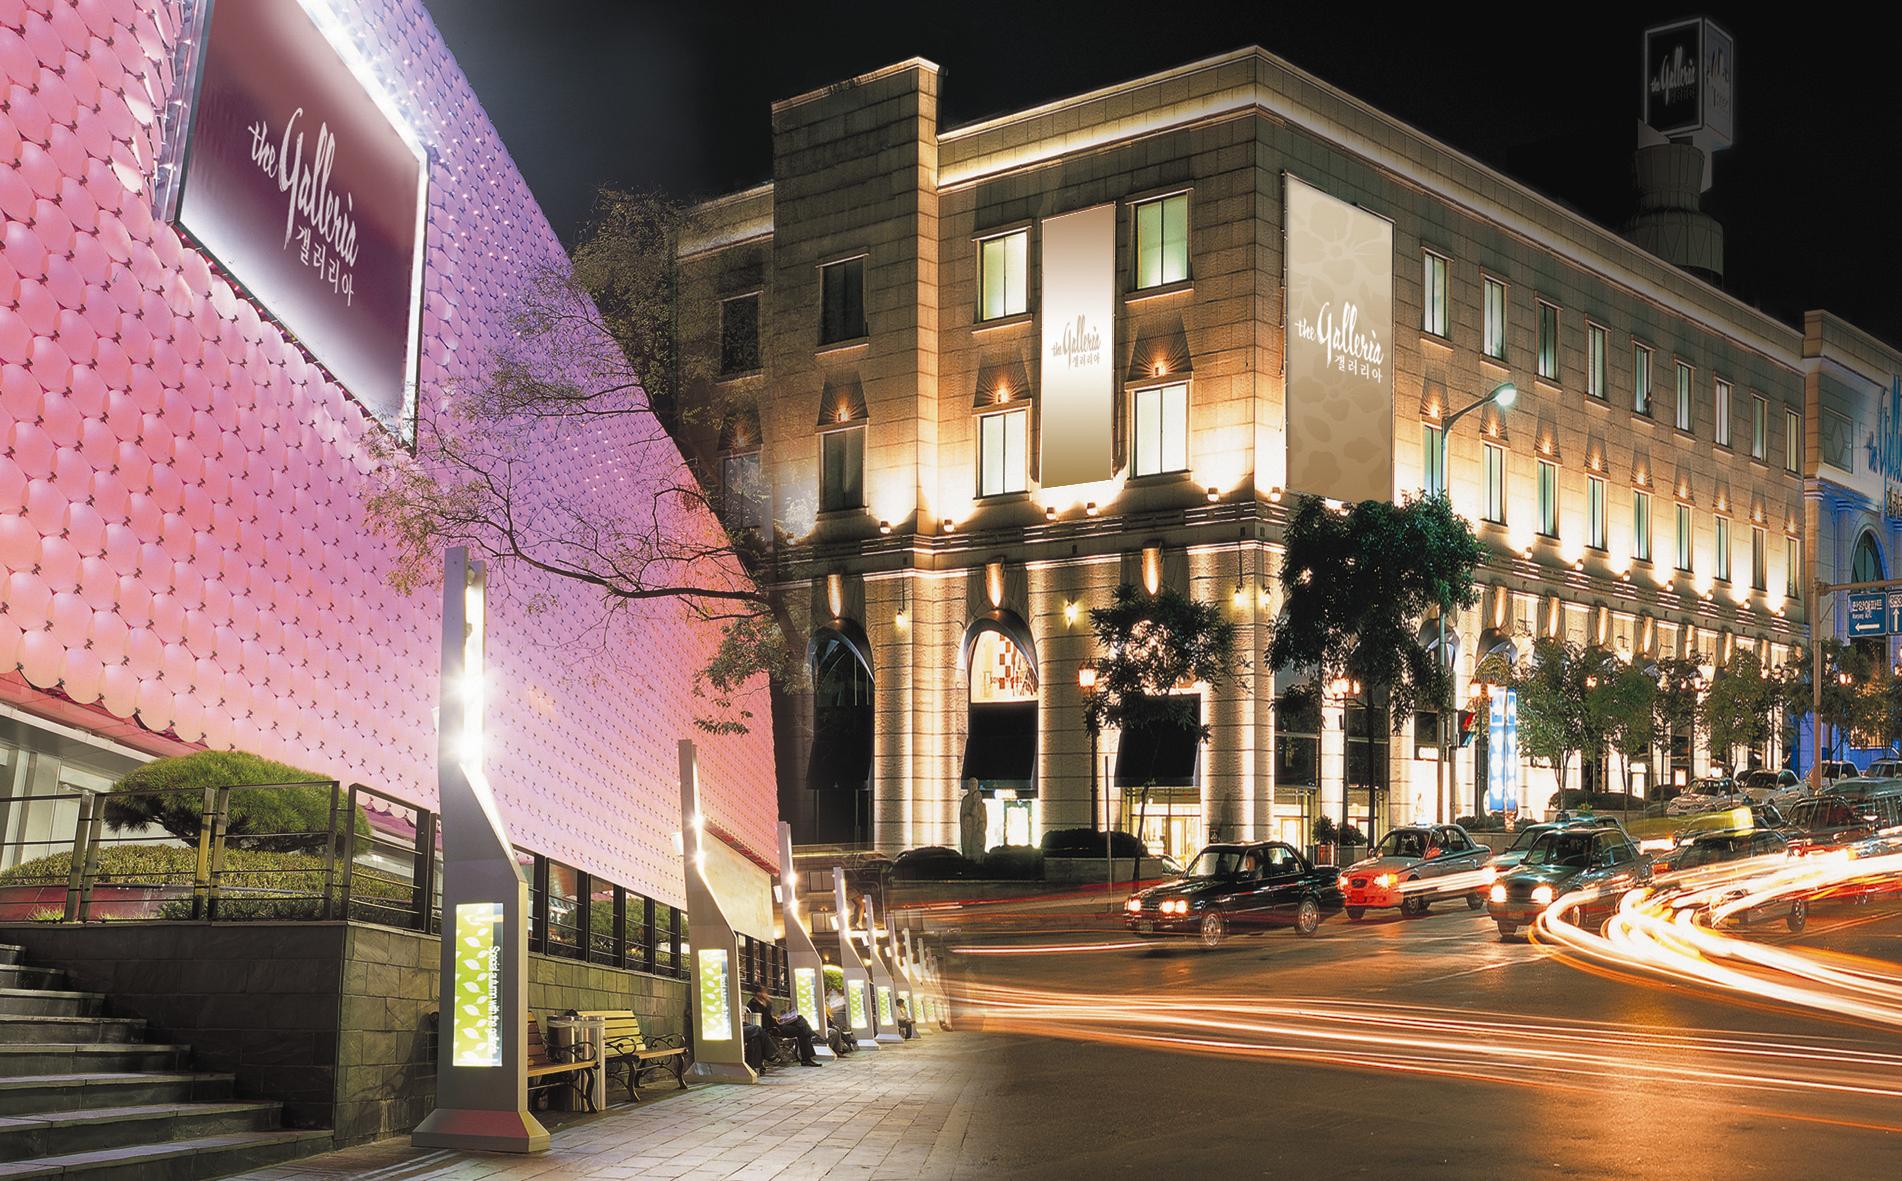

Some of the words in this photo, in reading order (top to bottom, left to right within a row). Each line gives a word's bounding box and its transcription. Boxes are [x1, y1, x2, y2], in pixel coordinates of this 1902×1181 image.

[247, 121, 278, 179] the
[278, 107, 359, 268] Galleria
[296, 225, 354, 307] 갤러리아
[1063, 312, 1101, 369] Galleria
[1294, 317, 1316, 341] the
[1317, 301, 1384, 368] Galleria
[1335, 355, 1383, 384] 갤러리아
